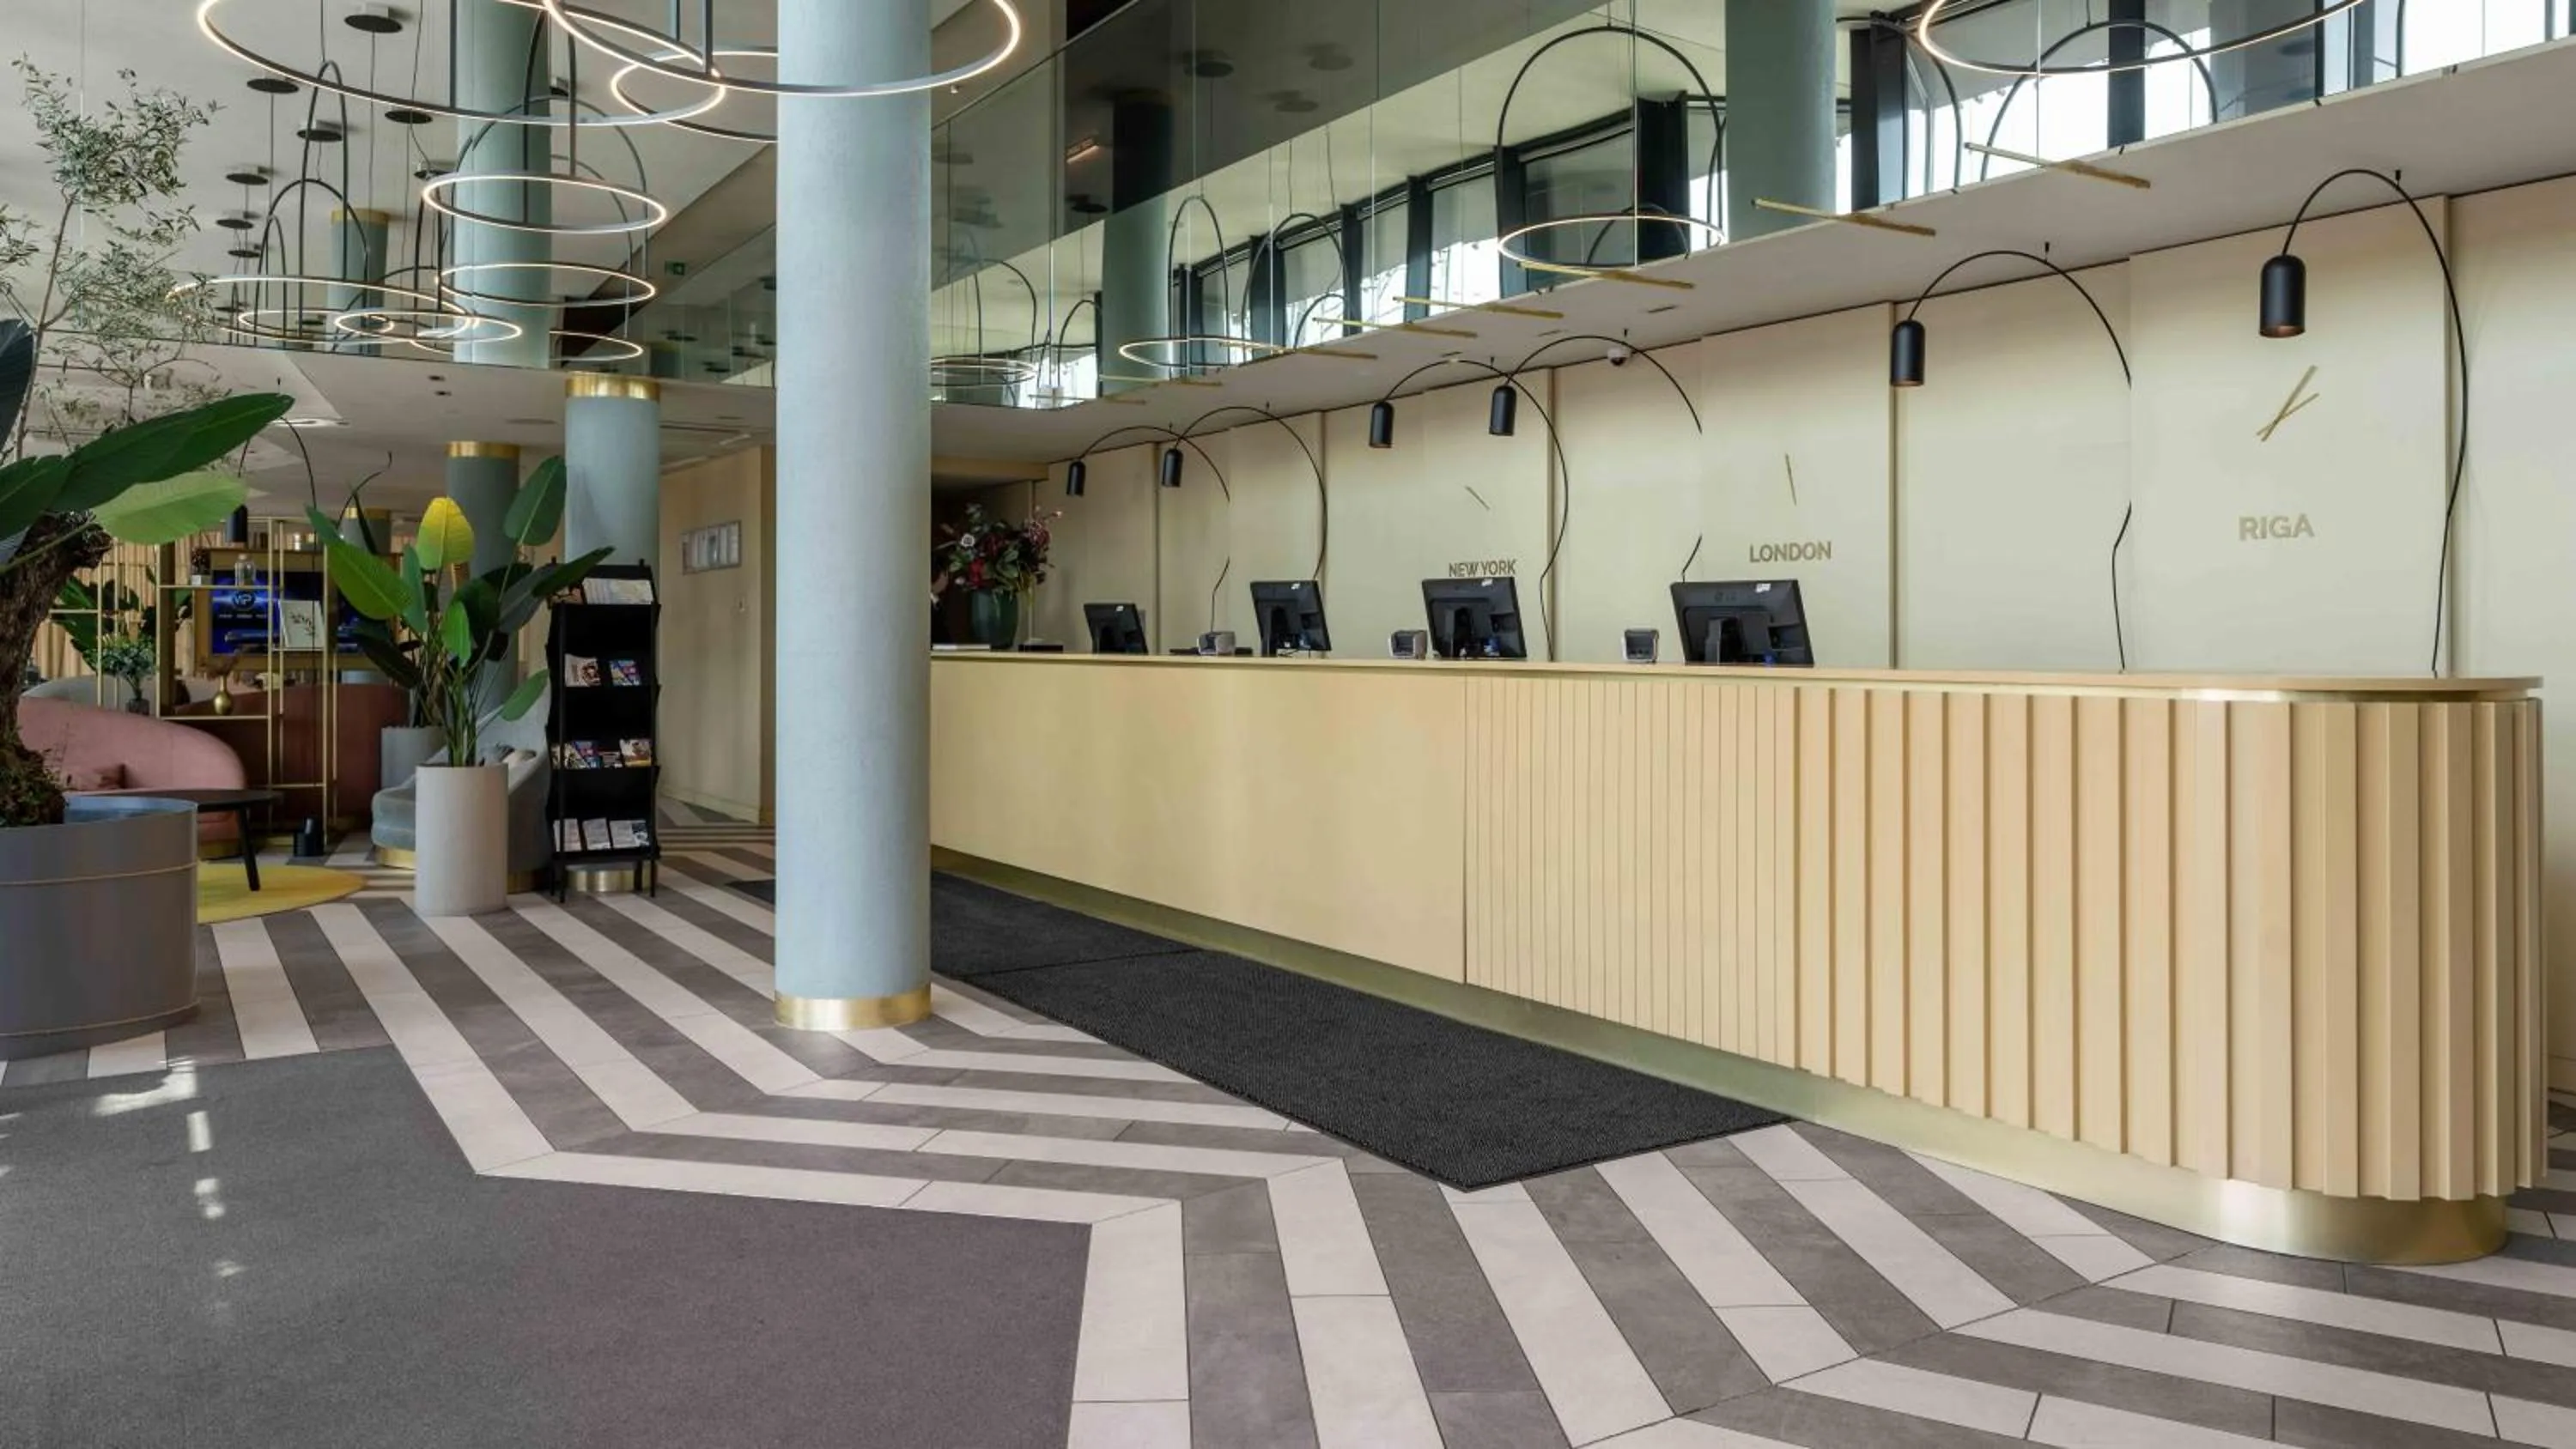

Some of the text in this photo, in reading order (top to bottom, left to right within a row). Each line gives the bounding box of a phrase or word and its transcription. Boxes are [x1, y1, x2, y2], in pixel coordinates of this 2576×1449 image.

[2239, 513, 2315, 541] RIGA
[1749, 541, 1832, 563] LONDON
[1449, 560, 1516, 577] NEW YORK
